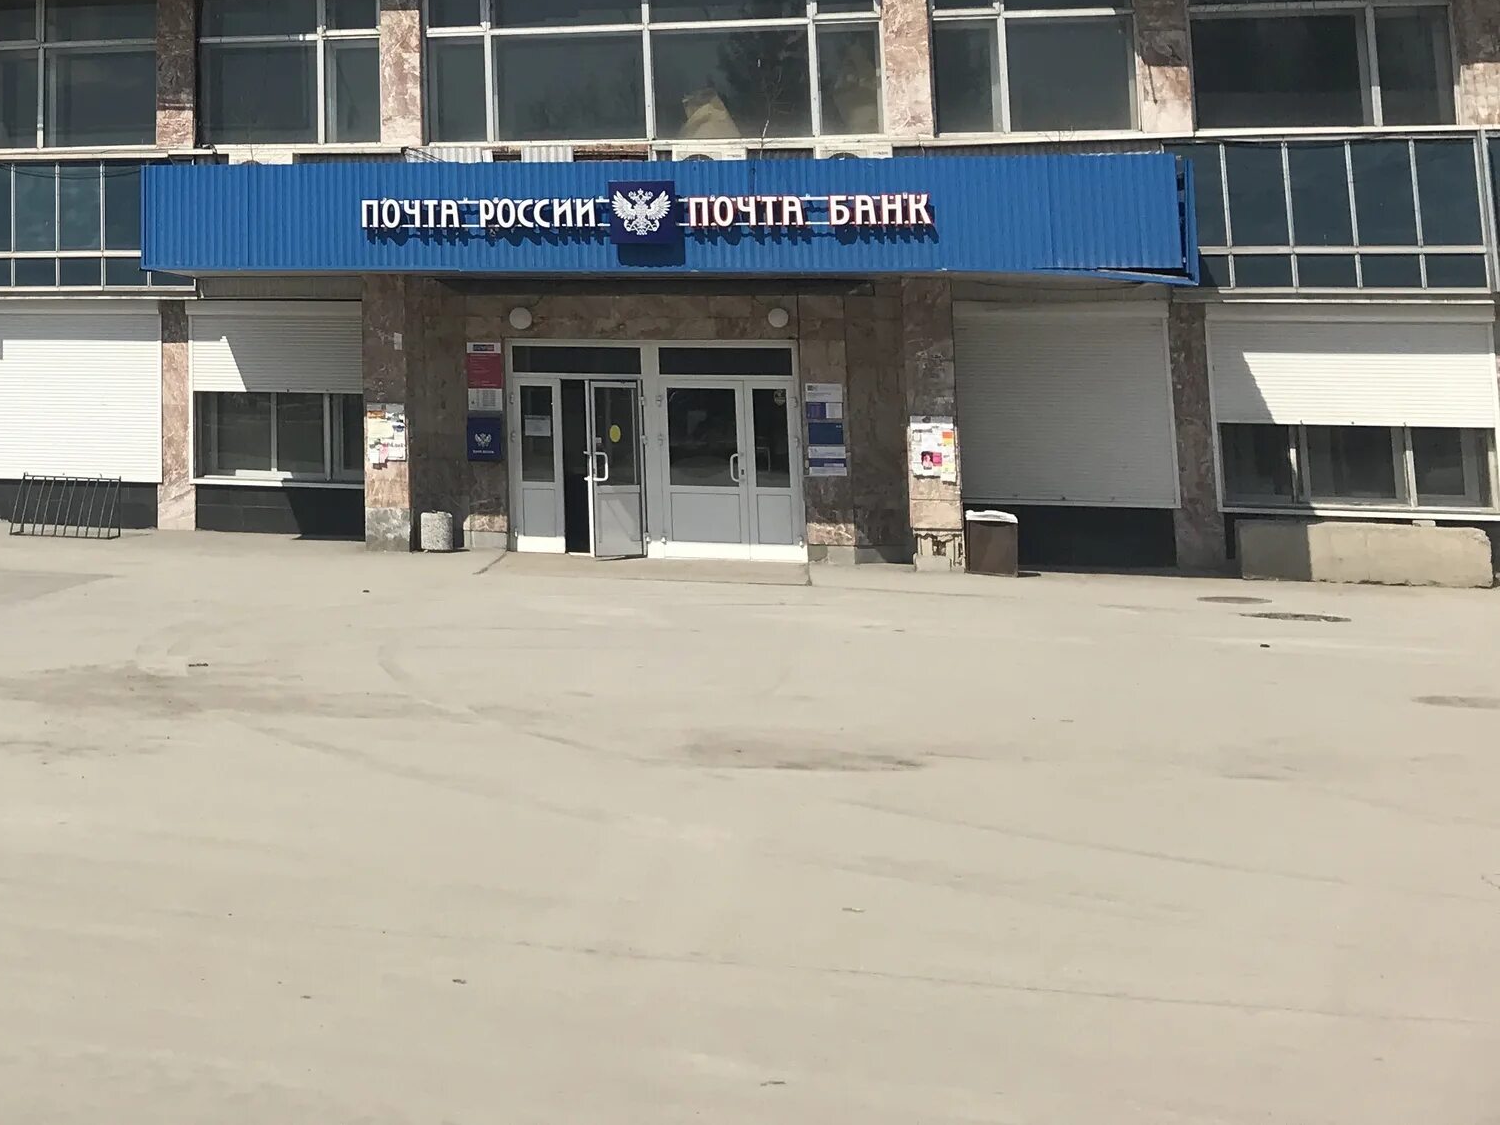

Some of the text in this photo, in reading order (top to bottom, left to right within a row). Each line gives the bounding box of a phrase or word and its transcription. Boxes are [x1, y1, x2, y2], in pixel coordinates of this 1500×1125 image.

[361, 197, 596, 229] ПОЧТА РОССИИ
[688, 193, 933, 227] ПОЧТА БАНК
